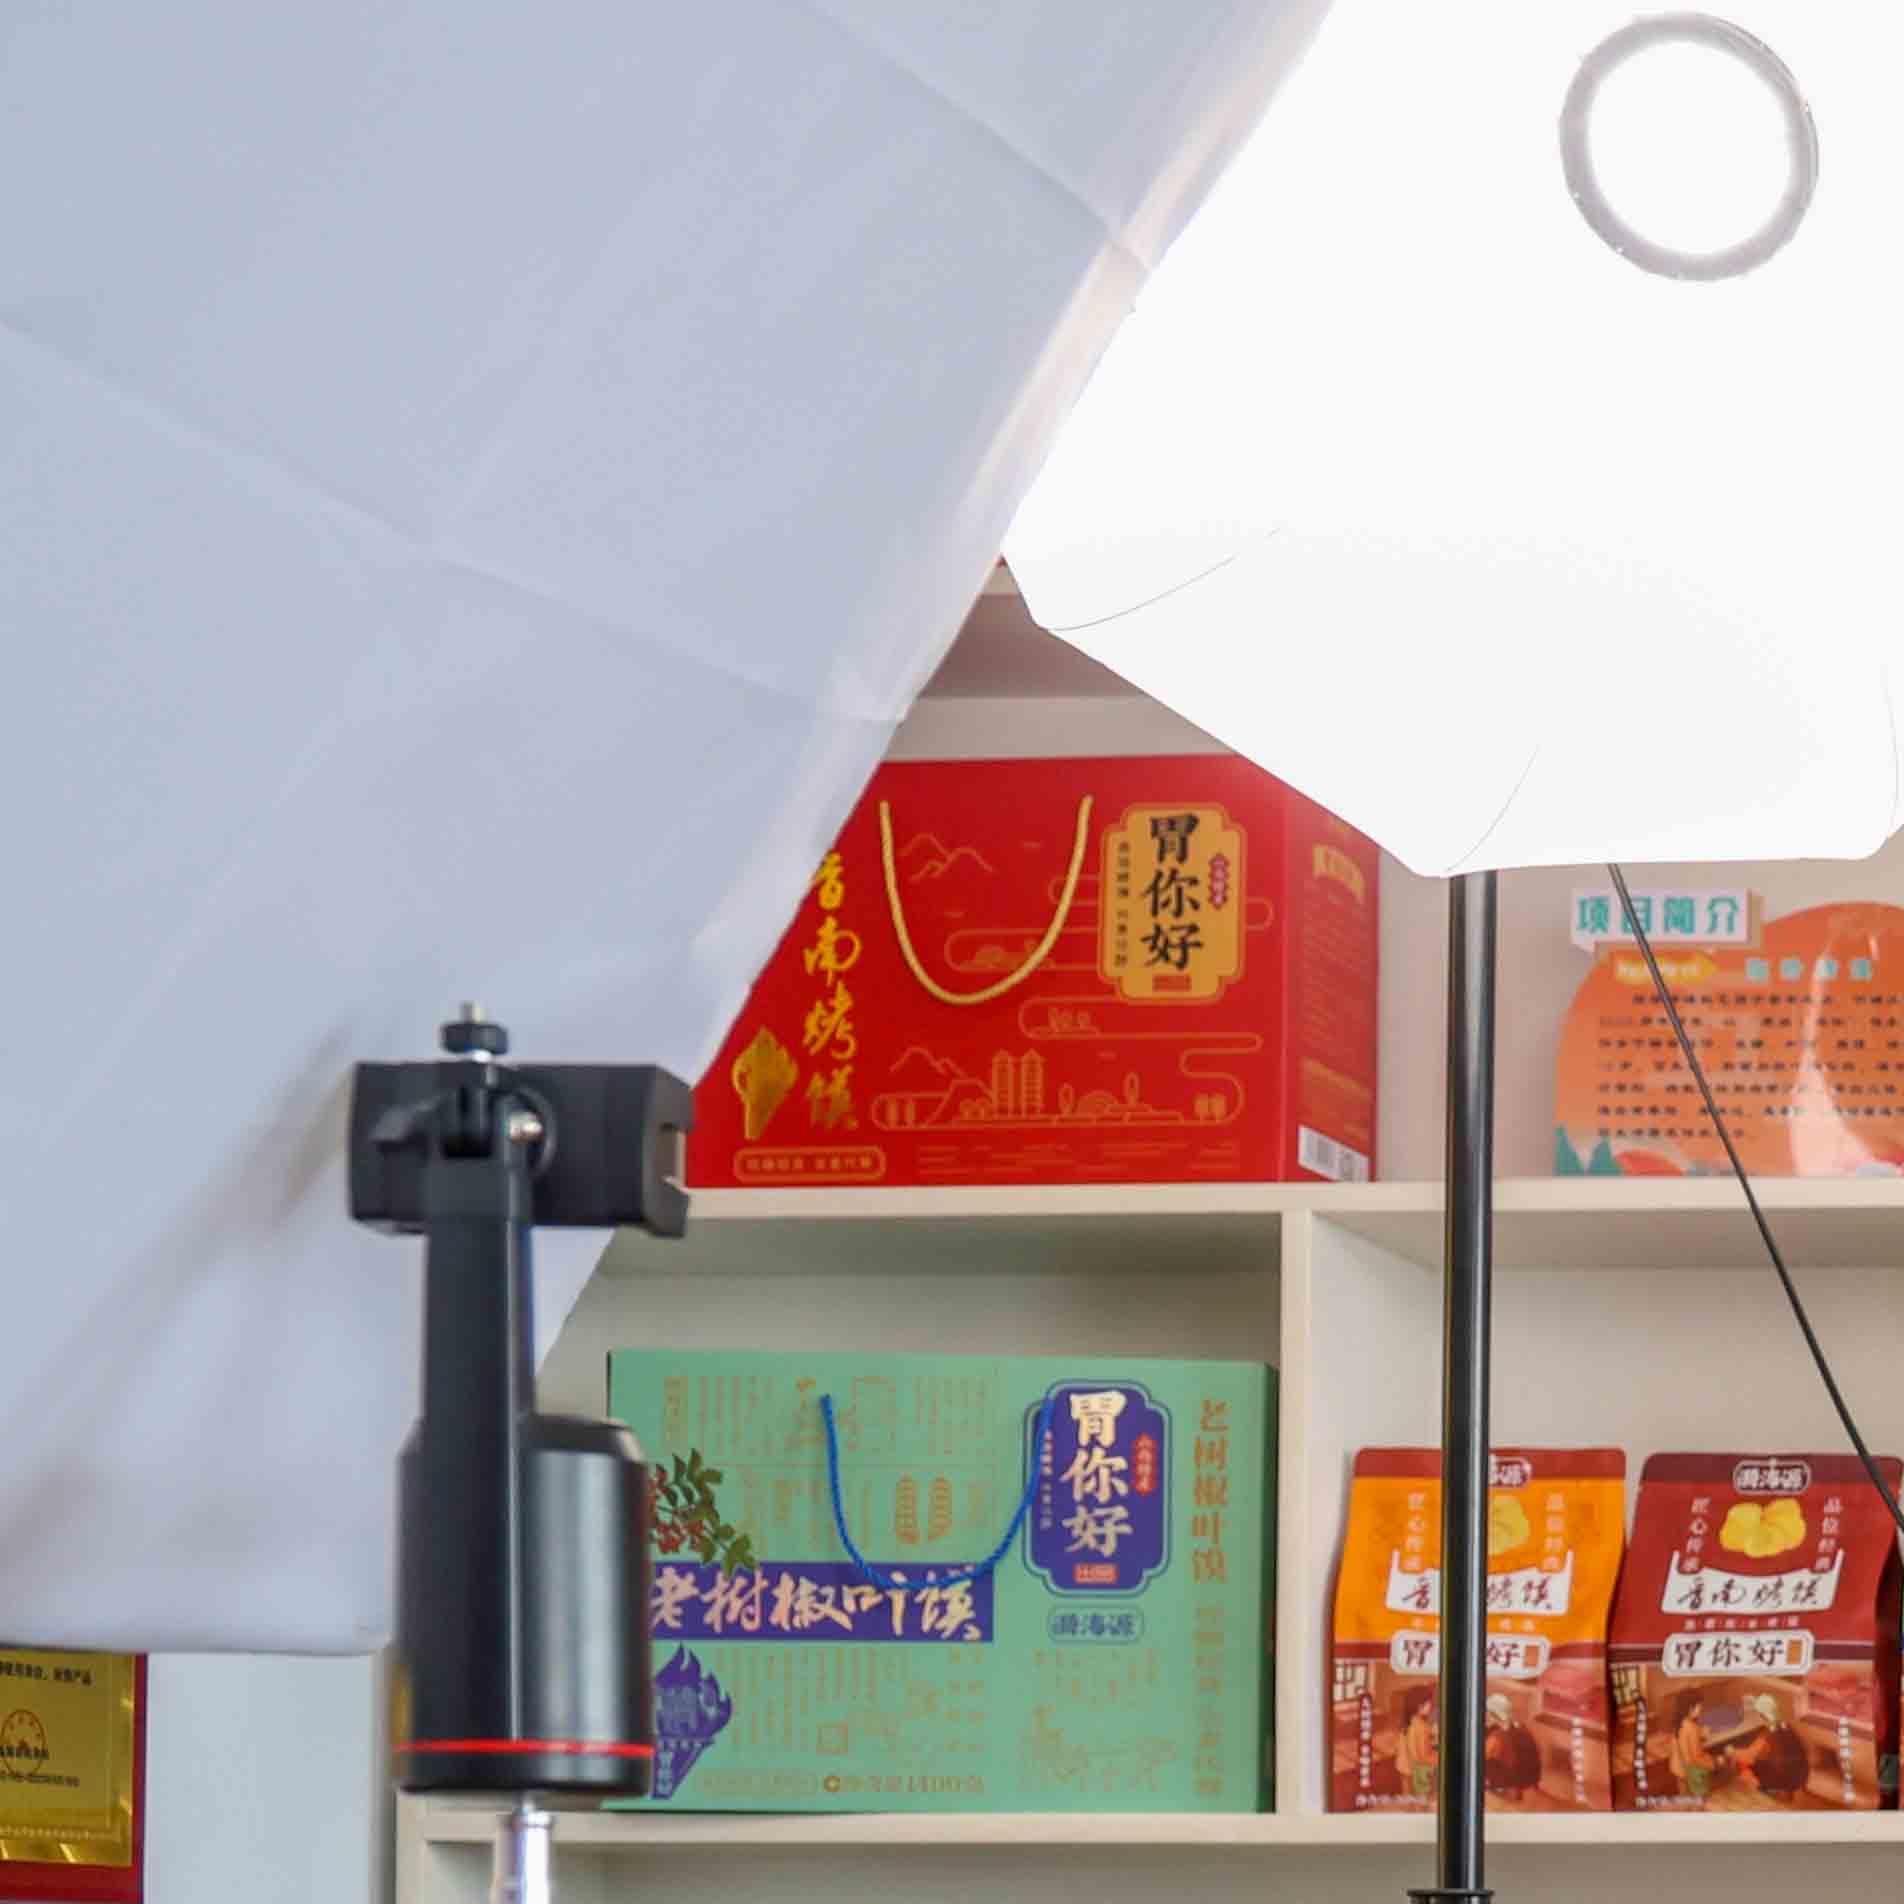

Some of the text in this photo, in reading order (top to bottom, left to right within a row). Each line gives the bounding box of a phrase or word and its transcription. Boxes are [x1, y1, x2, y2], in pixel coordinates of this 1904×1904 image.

[1140, 813, 1203, 971] 胃你好
[1577, 896, 1741, 934] 项目简介
[1060, 1390, 1133, 1558] 胃你好
[1402, 1577, 1553, 1610] 晋烤馍
[1403, 1639, 1521, 1667] 胃好
[1674, 1638, 1784, 1670] 胃你好
